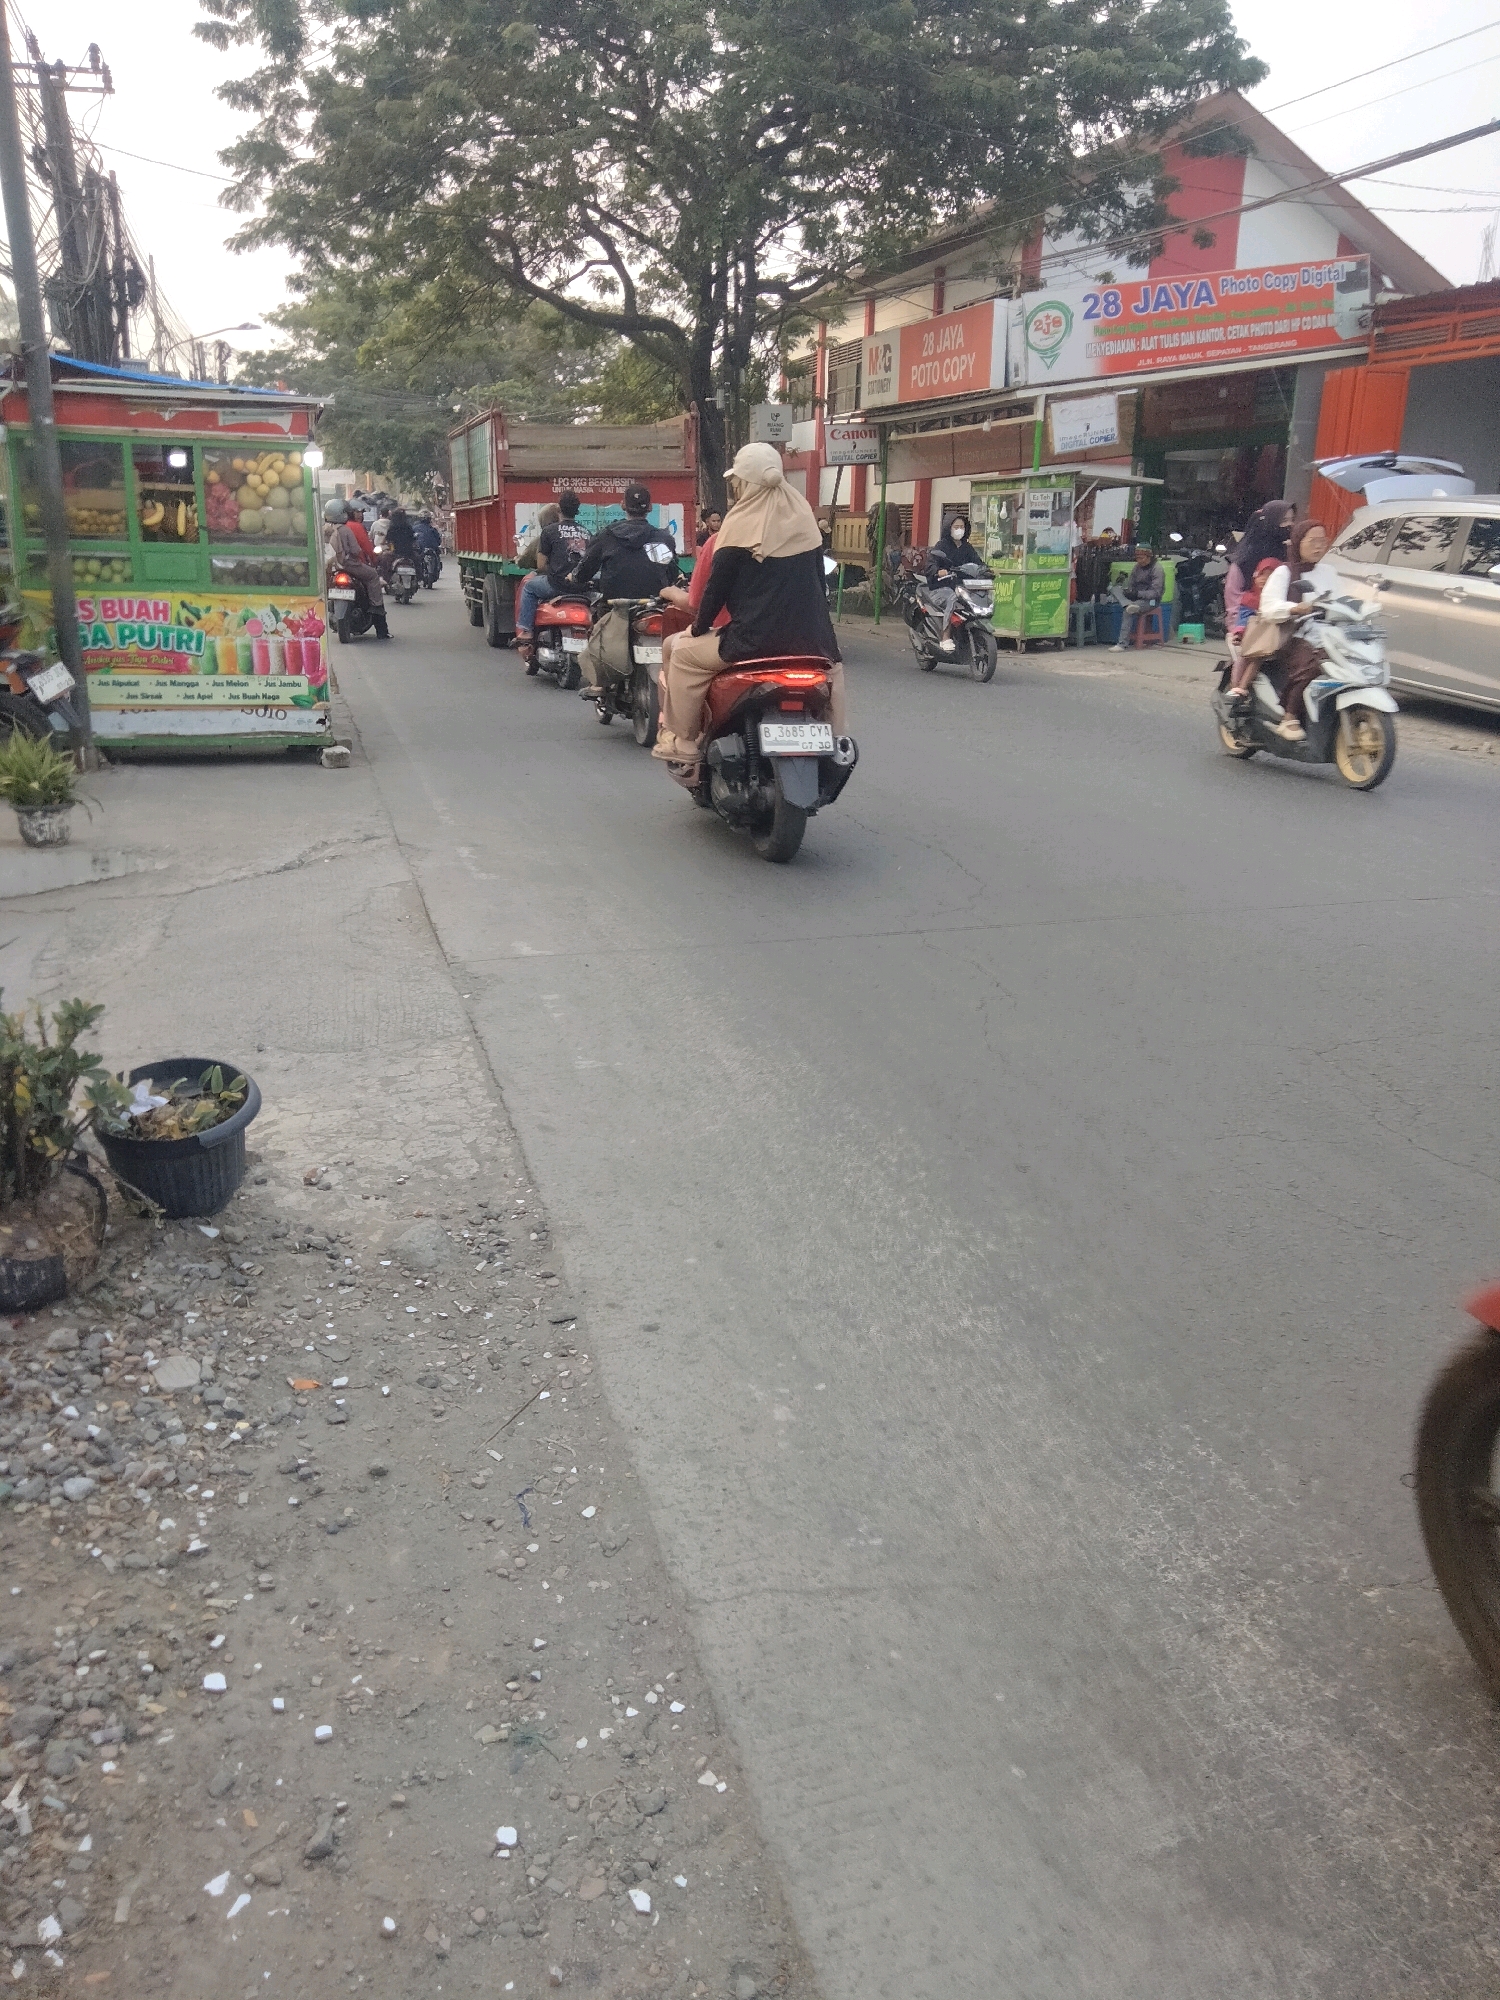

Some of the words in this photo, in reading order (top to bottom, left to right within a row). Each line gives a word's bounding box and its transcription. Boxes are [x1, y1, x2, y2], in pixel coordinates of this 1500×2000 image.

[1082, 289, 1122, 320] 28
[1131, 279, 1217, 315] JAYA
[1219, 275, 1260, 296] Photo
[1263, 271, 1299, 293] Copy
[1300, 264, 1347, 289] Digital
[922, 333, 935, 358] 28
[936, 324, 965, 354] JAYA
[1141, 335, 1159, 351] ALAT
[1160, 332, 1180, 349] TULIS
[911, 361, 939, 389] POTO
[942, 352, 976, 383] COPY
[829, 428, 877, 440] Canon
[1060, 440, 1088, 451] DIGITAL
[100, 597, 171, 624] BUAH
[115, 621, 206, 656] PUTRI
[97, 679, 110, 687] Jus
[155, 679, 168, 687] Jus
[170, 679, 200, 688] Mangga
[278, 680, 302, 688] Jambu
[140, 692, 163, 700] Sirsak
[183, 692, 195, 700] Jus
[197, 692, 213, 700] Apel
[242, 692, 260, 700] Buah
[262, 692, 280, 700] Naga
[763, 726, 771, 738] B
[777, 725, 805, 738] 3685
[809, 725, 831, 737] CYA
